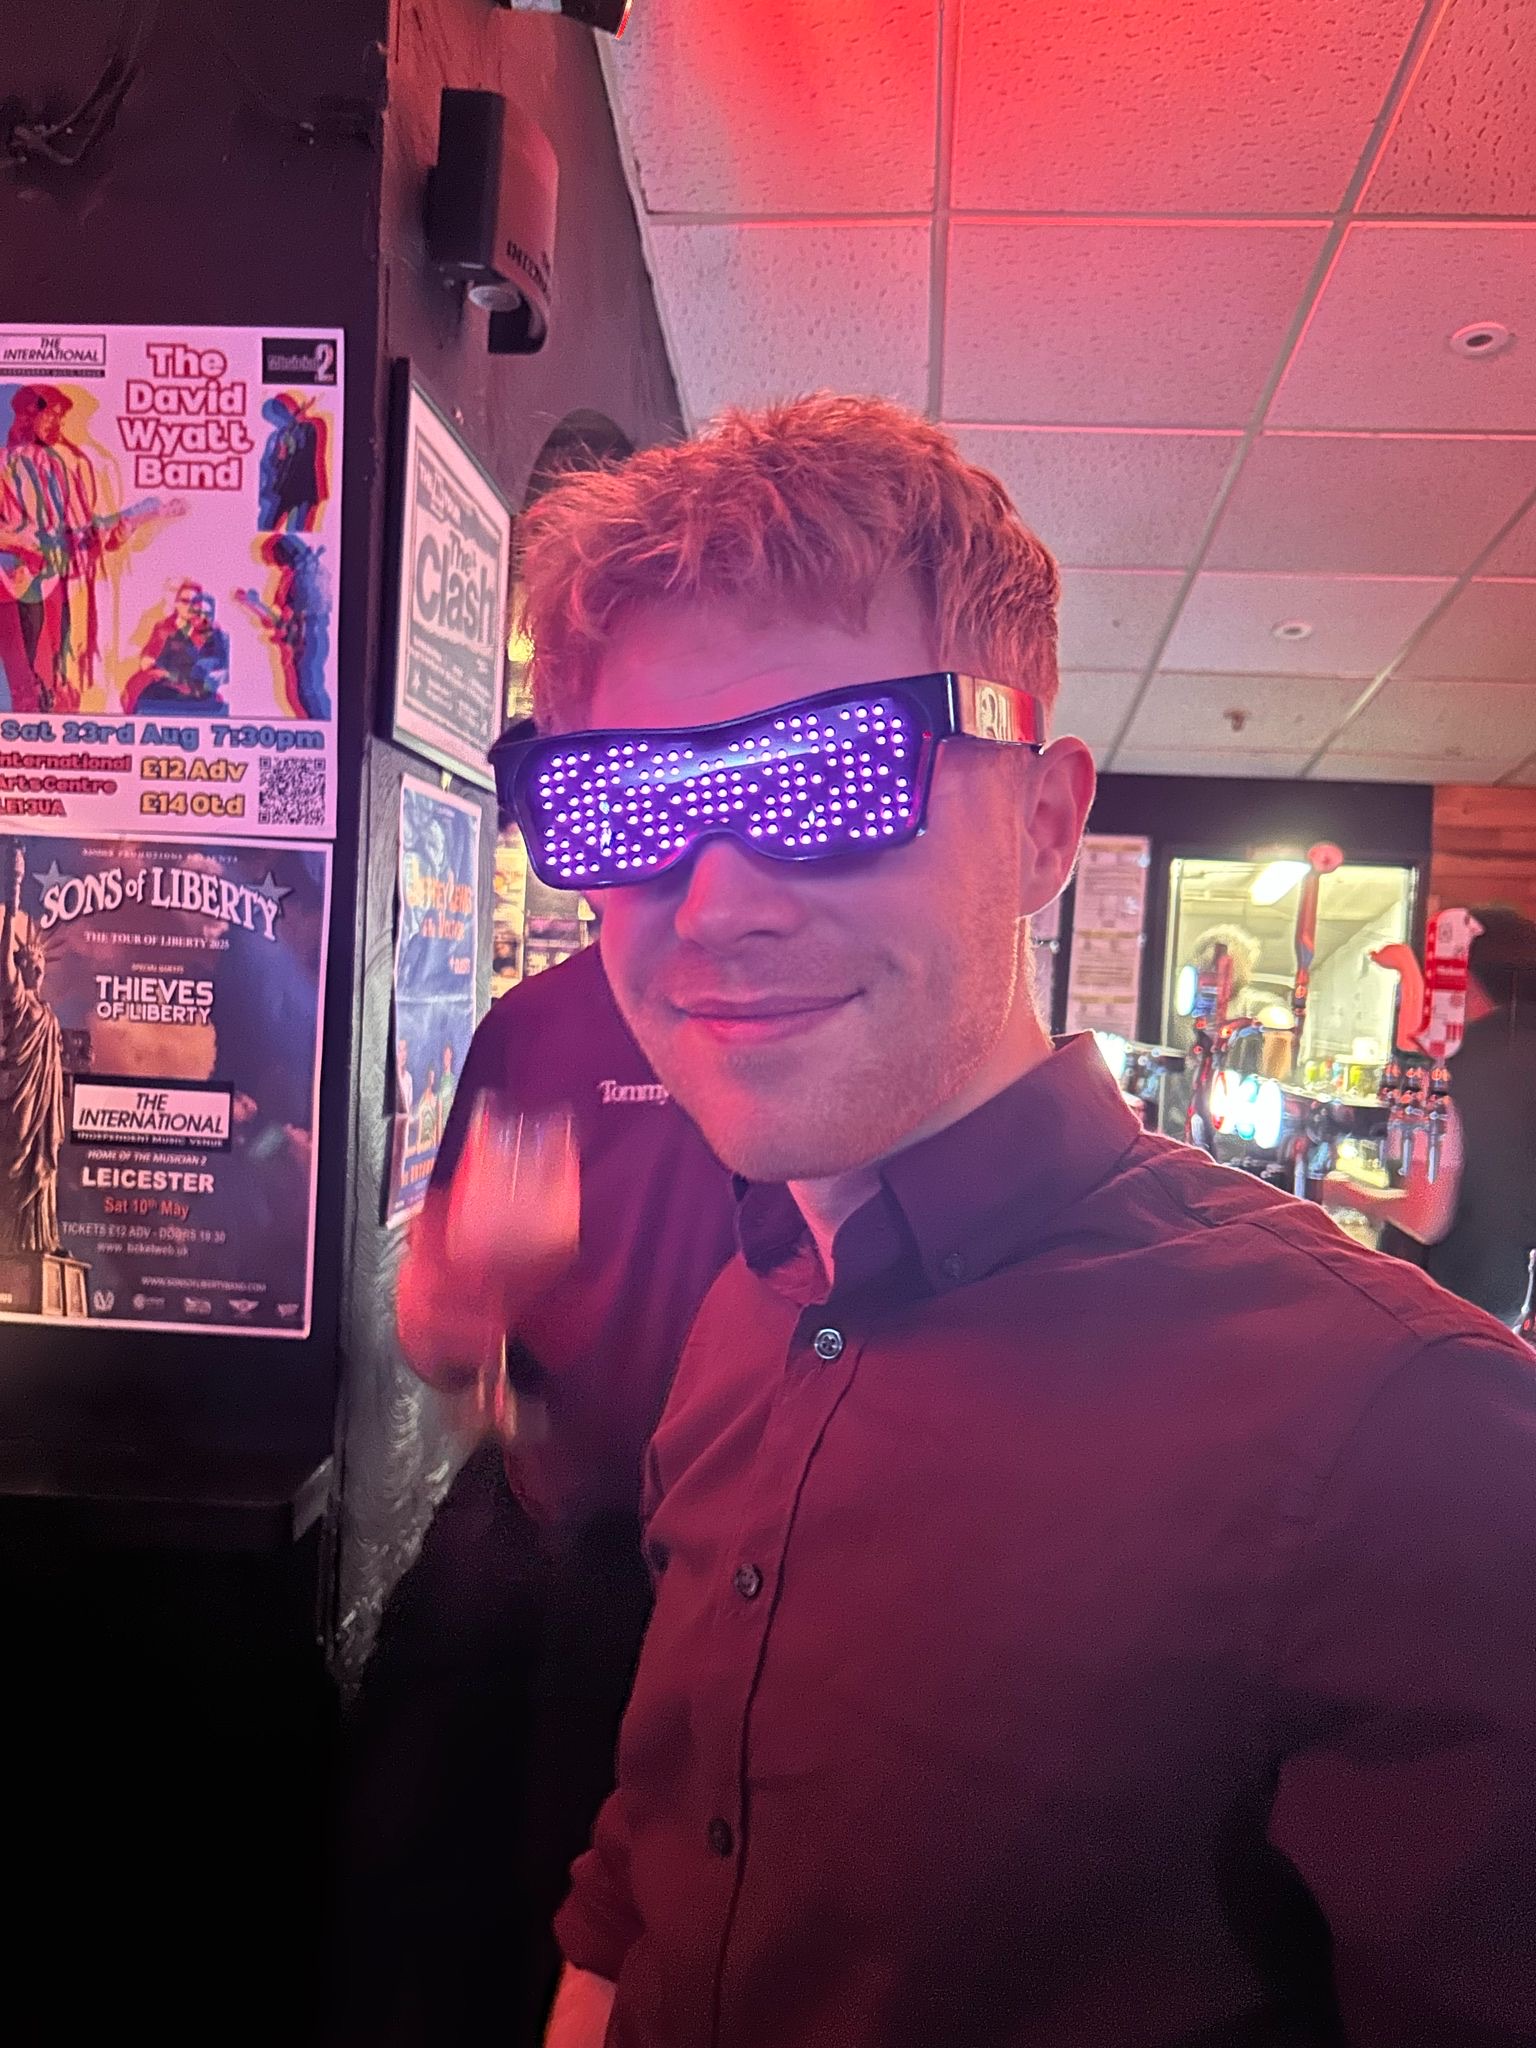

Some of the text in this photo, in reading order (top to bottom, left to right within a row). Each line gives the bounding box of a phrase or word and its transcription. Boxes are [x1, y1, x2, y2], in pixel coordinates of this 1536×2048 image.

[3, 348, 98, 361] INTERNATIONAL
[41, 336, 61, 349] THE
[146, 342, 227, 378] The
[126, 379, 246, 416] David
[117, 417, 255, 457] Wyatt
[135, 455, 242, 490] Band
[416, 533, 495, 644] Clash
[1, 720, 325, 750] Sat 23rd Aug 7:30pm
[0, 752, 132, 773] nternational
[140, 757, 248, 782] £12 Adv
[140, 791, 188, 815] £14
[41, 867, 279, 941] SONS of LIBERTY
[84, 931, 108, 944] THE
[111, 932, 142, 945] TOUR
[161, 935, 207, 949] LIBERTY
[96, 975, 213, 1005] THIEVES
[97, 1002, 211, 1024] OF LIBERTY
[136, 1092, 169, 1111] THE
[78, 1108, 223, 1134] INTERNATIONAL
[87, 1149, 117, 1161] HOME
[134, 1151, 151, 1162] THE
[82, 1166, 214, 1193] LEICESTER
[104, 1196, 128, 1214] Sat
[160, 1199, 190, 1220] May
[61, 1221, 106, 1236] TICKETS
[129, 1224, 151, 1239] ADV
